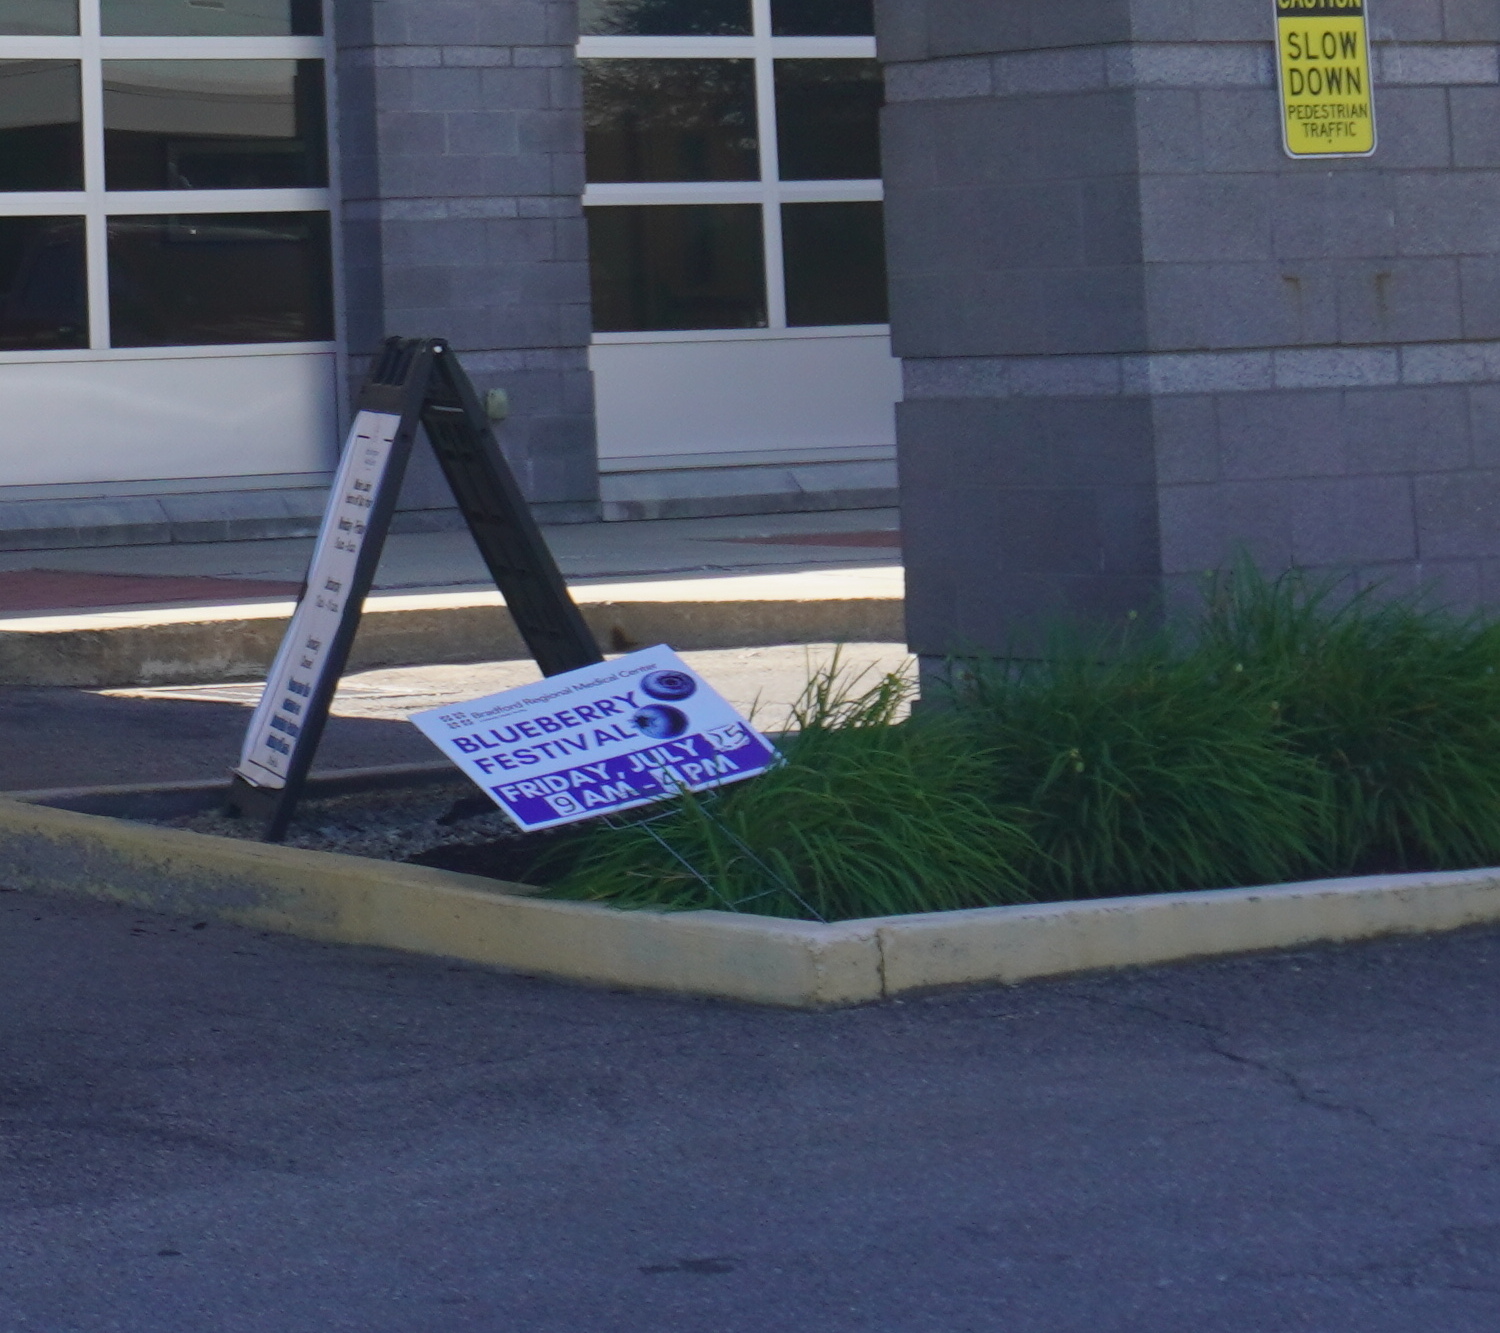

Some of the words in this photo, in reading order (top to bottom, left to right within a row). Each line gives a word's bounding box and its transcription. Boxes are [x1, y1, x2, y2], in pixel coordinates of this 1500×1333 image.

[1287, 31, 1357, 61] SLOW
[1290, 67, 1362, 96] DOWN
[1288, 103, 1368, 120] PEDESTRIAN
[1303, 121, 1357, 138] TRAFFIC
[471, 700, 524, 720] Bradford
[522, 687, 573, 707] Regional
[571, 674, 617, 692] Medical
[618, 663, 658, 679] Center
[451, 690, 644, 755] BLUEBERRY
[472, 723, 639, 775] FESTIVAL
[500, 762, 626, 803] FRIDAY,
[628, 738, 699, 773] JULY
[554, 796, 577, 814] 9
[582, 780, 640, 808] AM
[681, 754, 740, 781] PM
